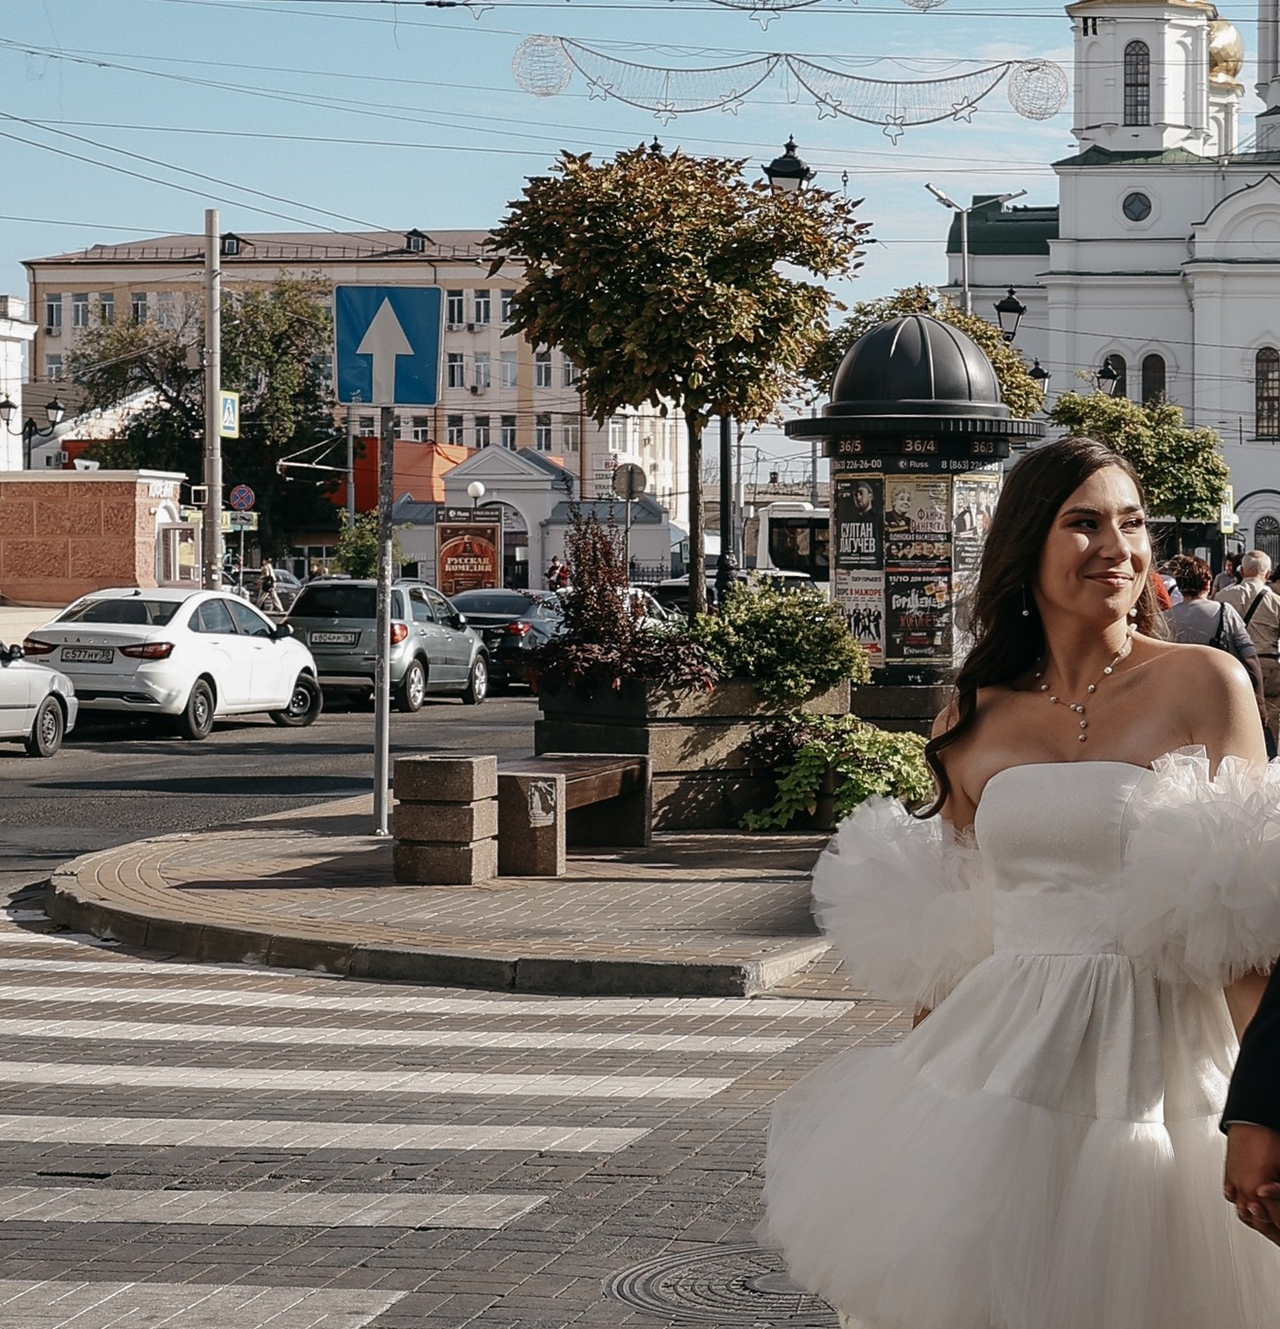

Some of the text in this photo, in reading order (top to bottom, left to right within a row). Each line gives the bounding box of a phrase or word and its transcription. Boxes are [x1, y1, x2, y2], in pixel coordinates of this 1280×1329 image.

[839, 440, 862, 452] 36/5
[905, 439, 936, 452] 36/4
[973, 442, 994, 453] 36/3
[846, 459, 882, 469] 226-26-00
[909, 460, 929, 468] Russ
[941, 460, 948, 469] 8
[949, 459, 969, 470] (863)
[841, 522, 873, 538] СУЛТАН
[840, 538, 876, 553] ЛАГУЧЕВ
[447, 557, 490, 565] РУССКАЯ
[445, 564, 492, 572] КОМЕДИЯ
